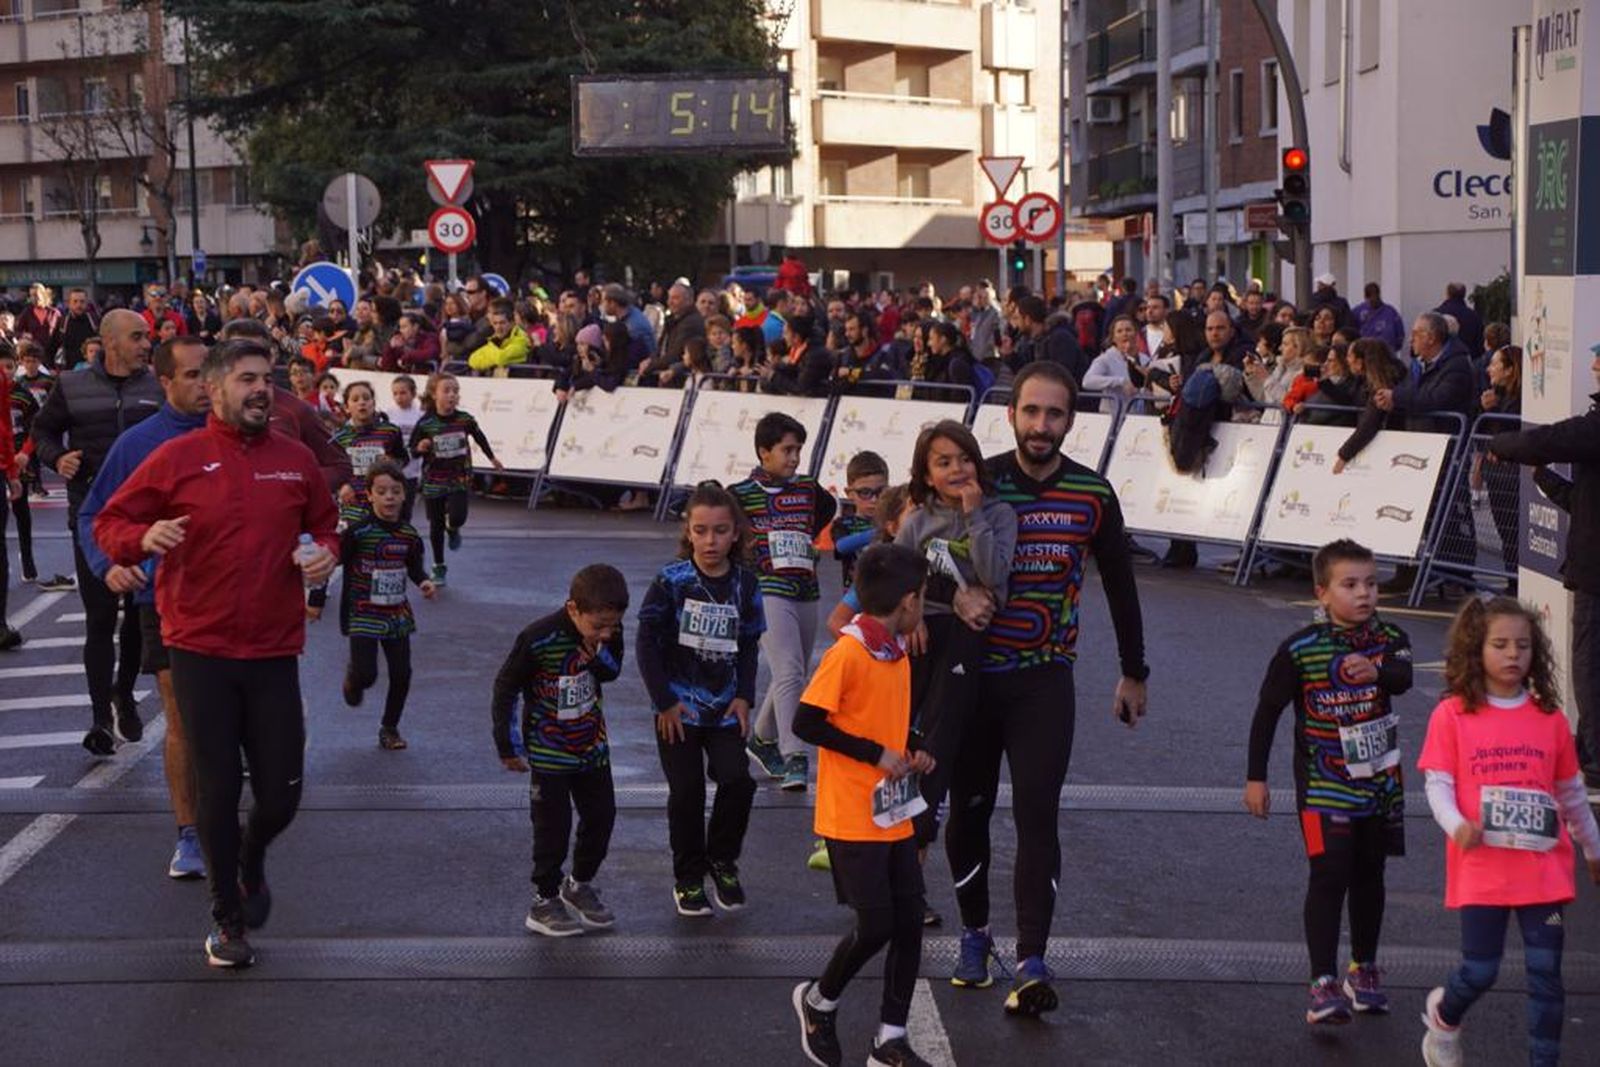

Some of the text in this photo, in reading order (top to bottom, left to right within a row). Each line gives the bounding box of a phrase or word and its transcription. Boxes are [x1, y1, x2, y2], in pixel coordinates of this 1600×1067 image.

[670, 91, 775, 135] 5:14
[1468, 204, 1502, 220] San
[439, 222, 464, 238] 30
[990, 214, 1013, 230] 30
[1022, 511, 1072, 526] XXXVIII
[689, 613, 729, 636] 6078
[1504, 790, 1555, 807] SETEL
[1490, 803, 1546, 831] 6238
